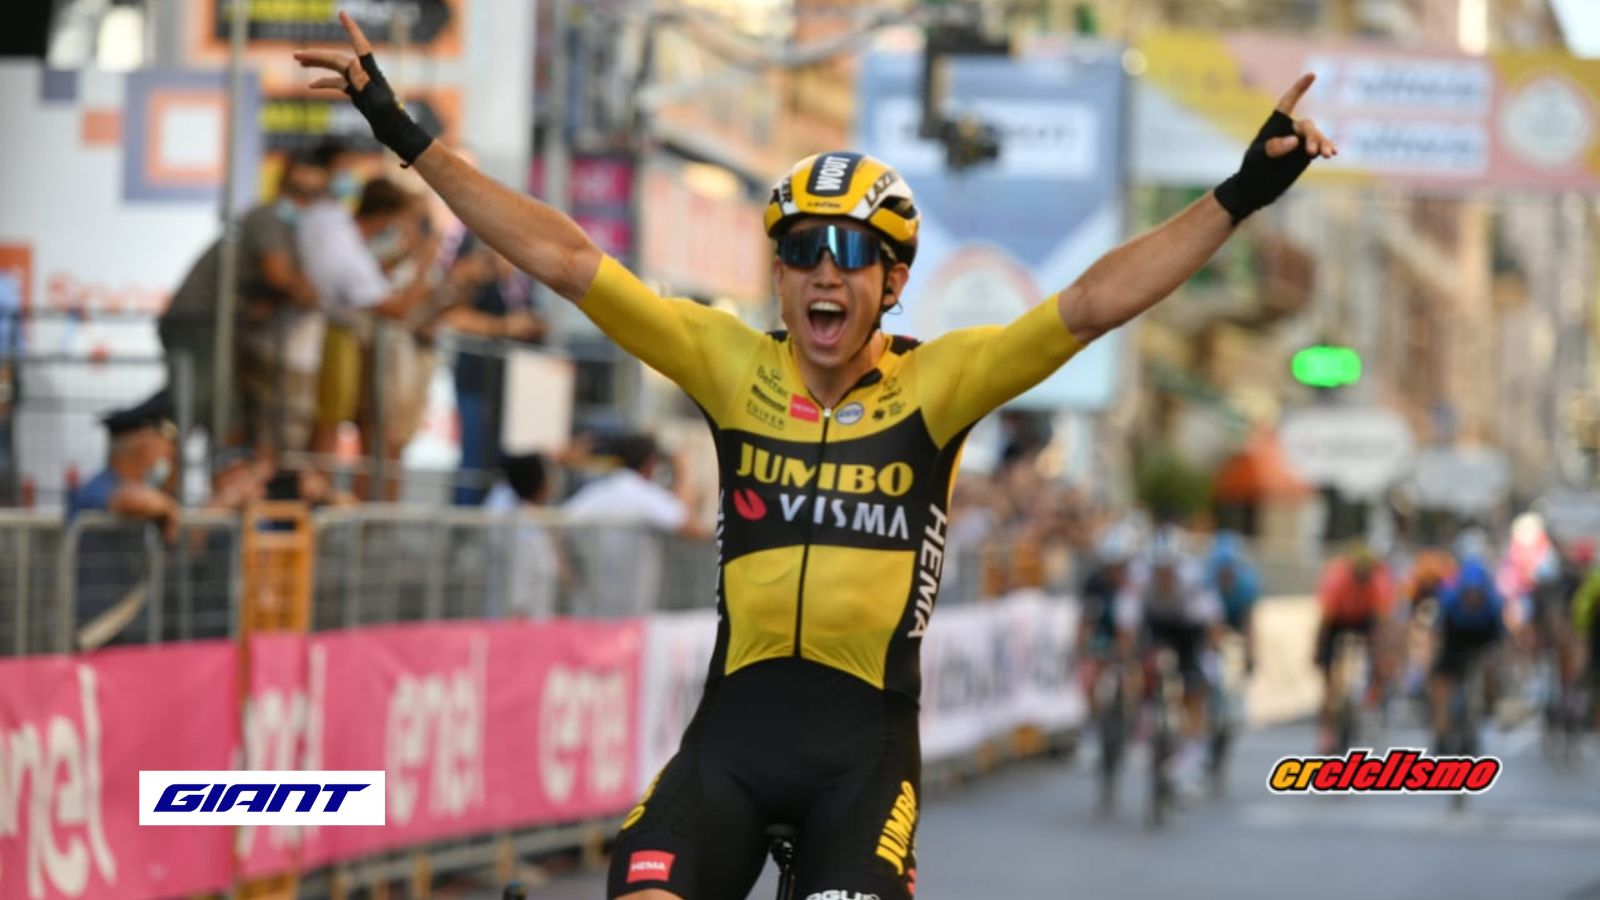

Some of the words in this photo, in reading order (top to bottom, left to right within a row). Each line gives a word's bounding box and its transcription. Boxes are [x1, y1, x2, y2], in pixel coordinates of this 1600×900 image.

[814, 156, 850, 191] WOUT
[736, 442, 914, 497] JUMBO
[779, 493, 909, 540] VISMA
[907, 503, 947, 638] HEMA
[876, 780, 916, 875] JUMBO
